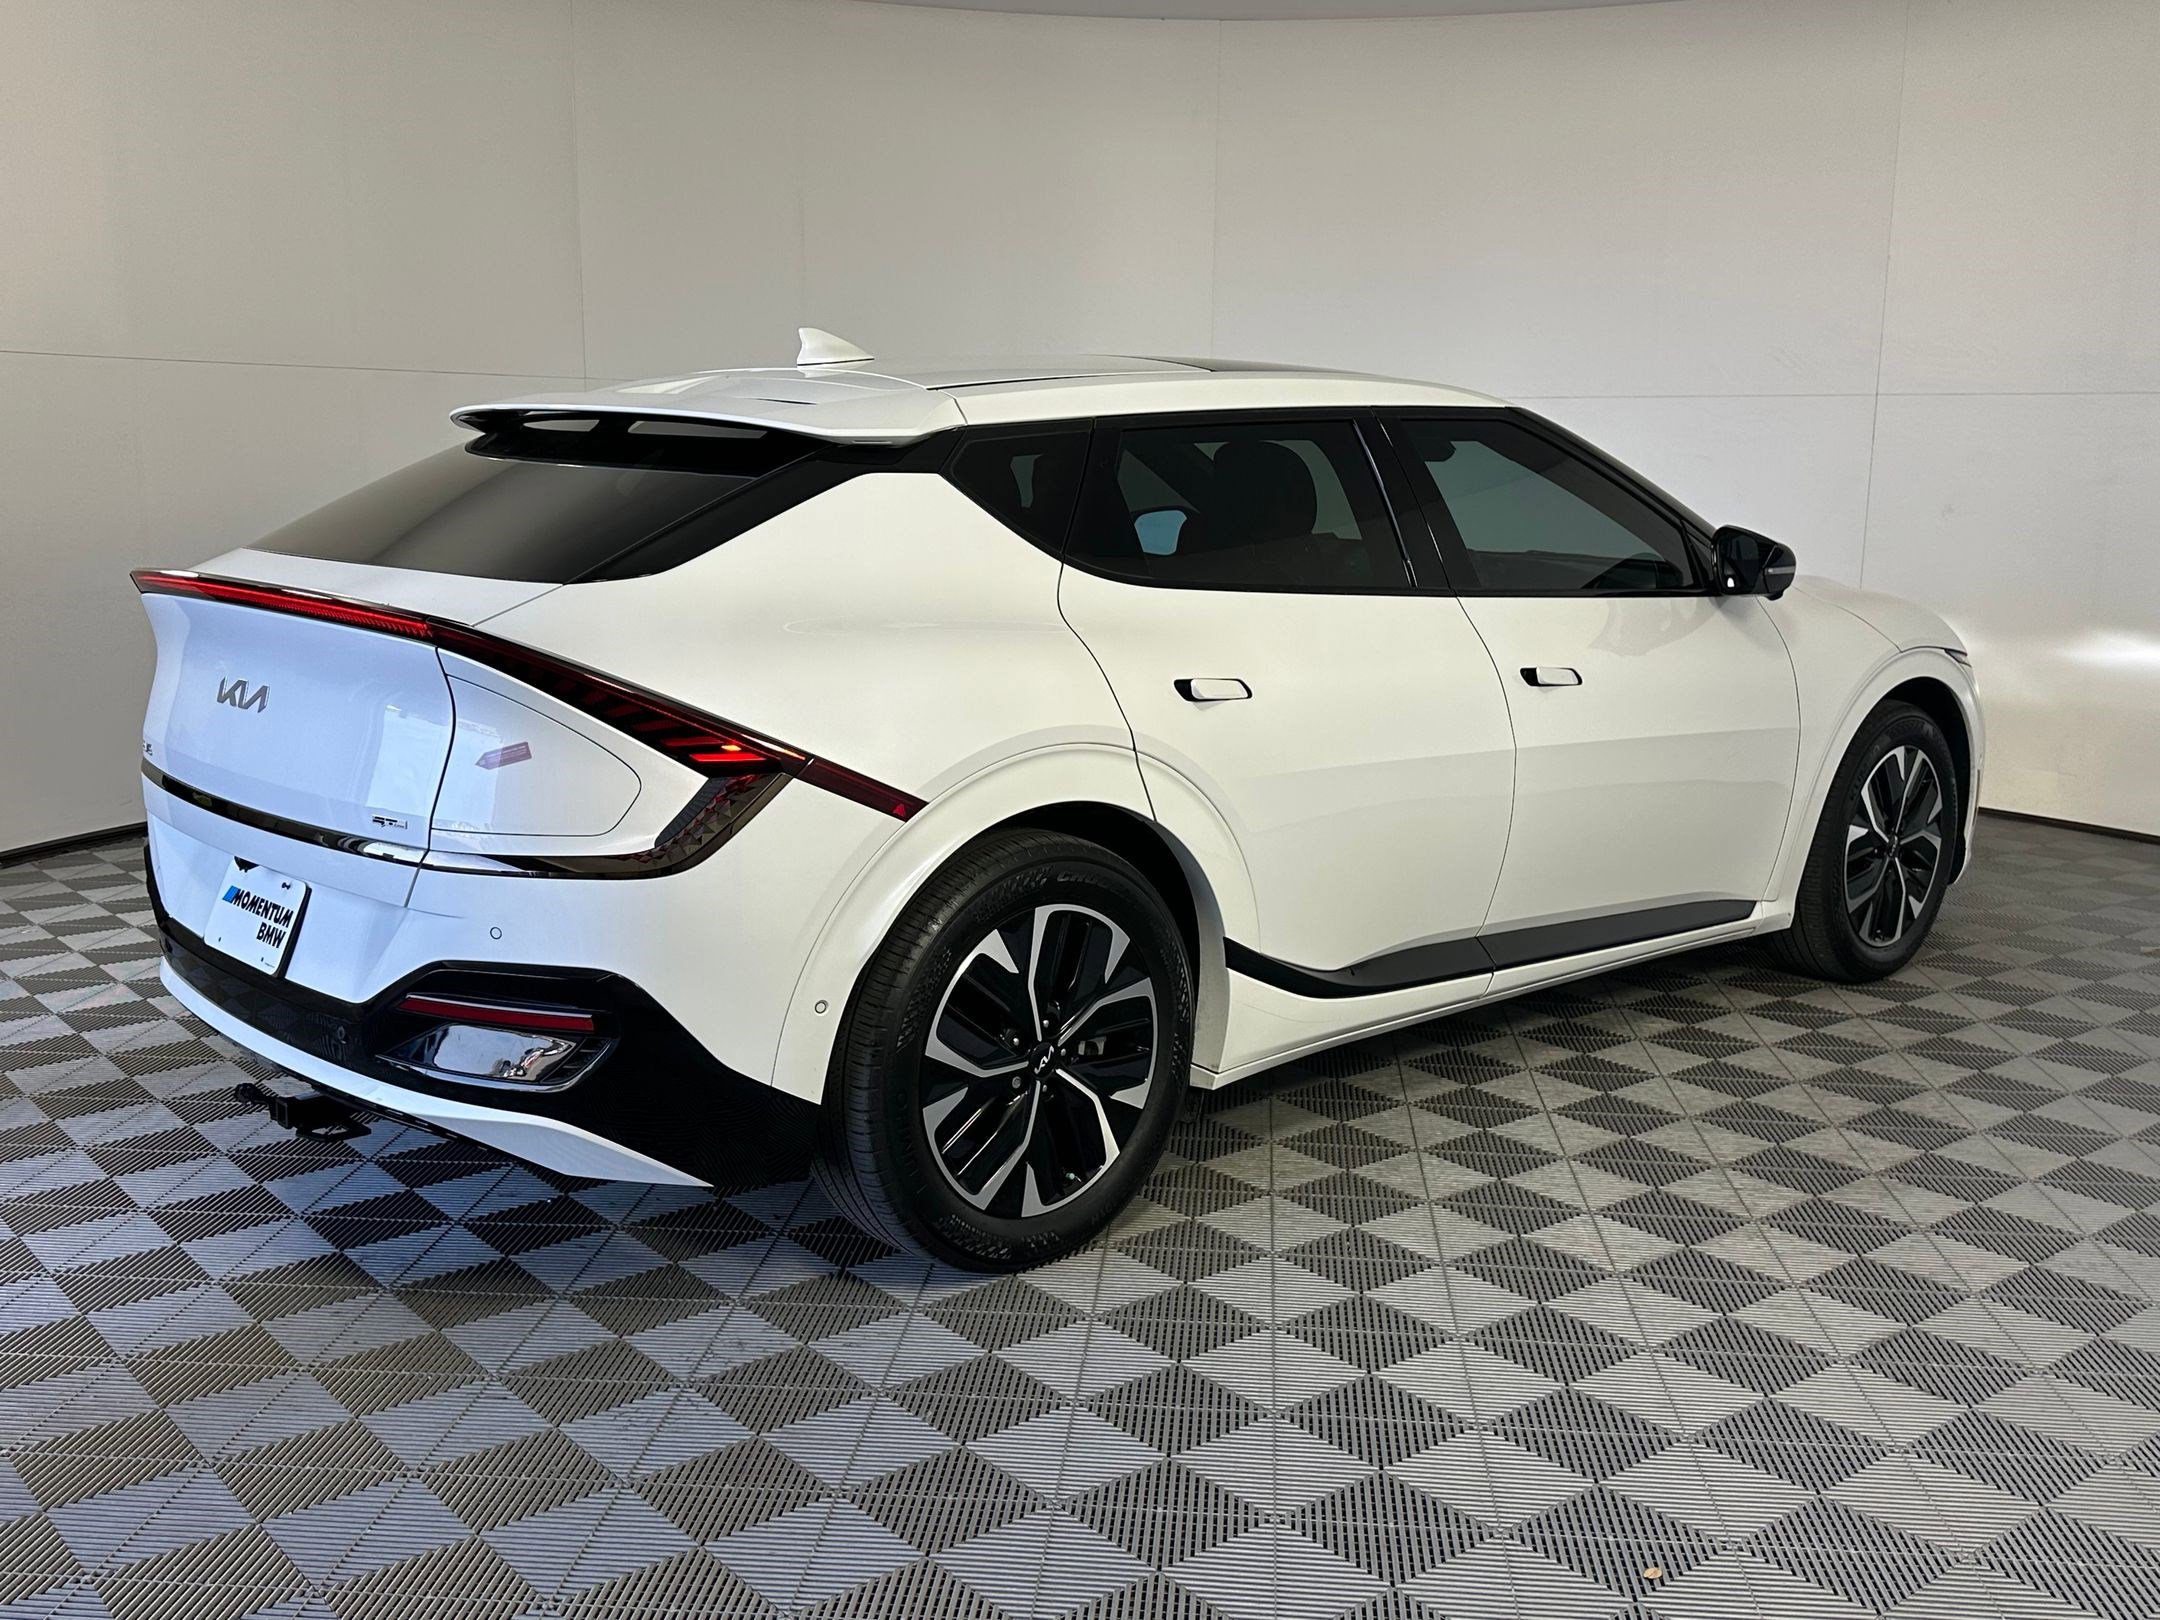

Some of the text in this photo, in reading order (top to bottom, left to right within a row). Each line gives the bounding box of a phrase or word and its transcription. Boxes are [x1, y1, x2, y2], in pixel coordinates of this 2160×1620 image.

[217, 677, 270, 713] KIA
[231, 888, 294, 928] MOMENTUM
[256, 922, 286, 949] BMW
